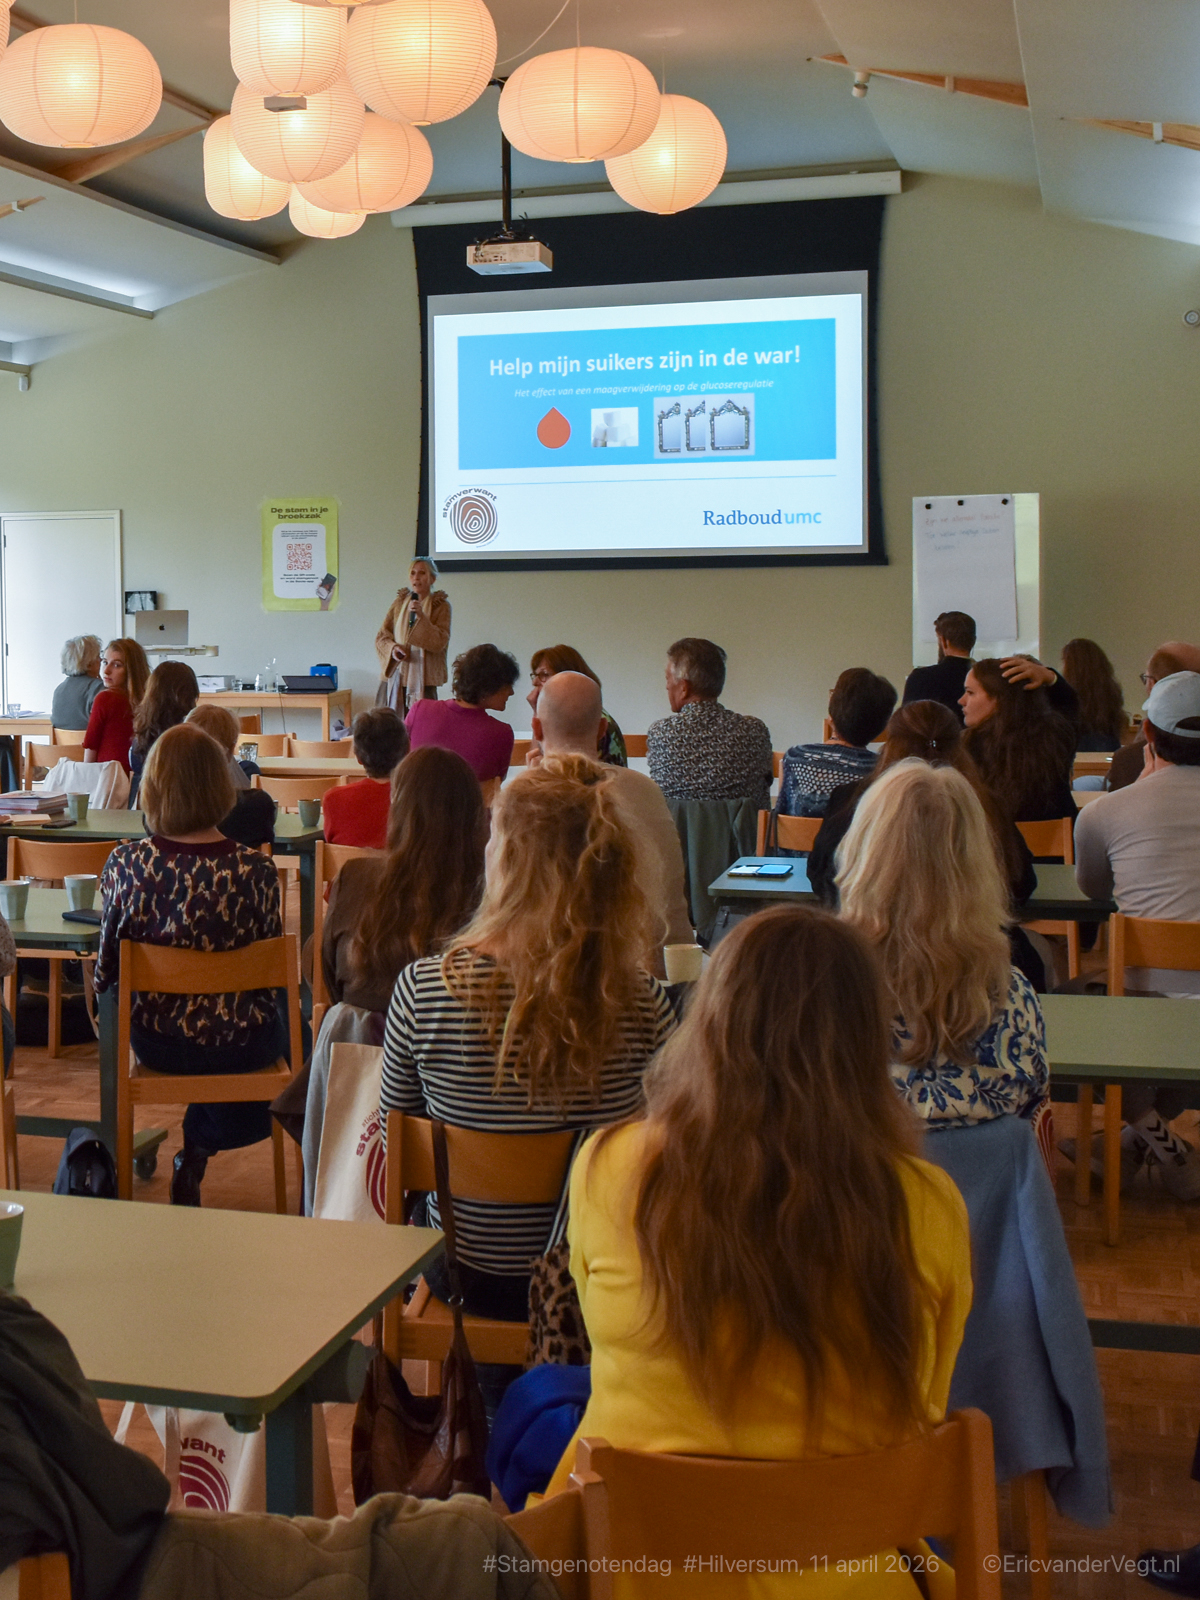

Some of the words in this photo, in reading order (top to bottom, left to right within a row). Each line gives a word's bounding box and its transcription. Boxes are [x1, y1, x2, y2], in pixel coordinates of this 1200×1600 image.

[490, 357, 533, 379] Help
[539, 355, 581, 377] mijn
[586, 353, 654, 372] suikers
[659, 351, 693, 372] zijn
[699, 349, 717, 367] in
[723, 347, 748, 366] de
[754, 345, 800, 365] war!
[514, 389, 530, 398] Het
[531, 387, 556, 399] effect
[558, 387, 574, 396] van
[575, 387, 591, 395] een
[593, 382, 671, 396] maagverwijdering
[673, 383, 685, 392] op
[687, 381, 698, 391] de
[700, 379, 774, 392] glucoseregulatie
[319, 506, 329, 514] je
[442, 488, 498, 518] stamverwant
